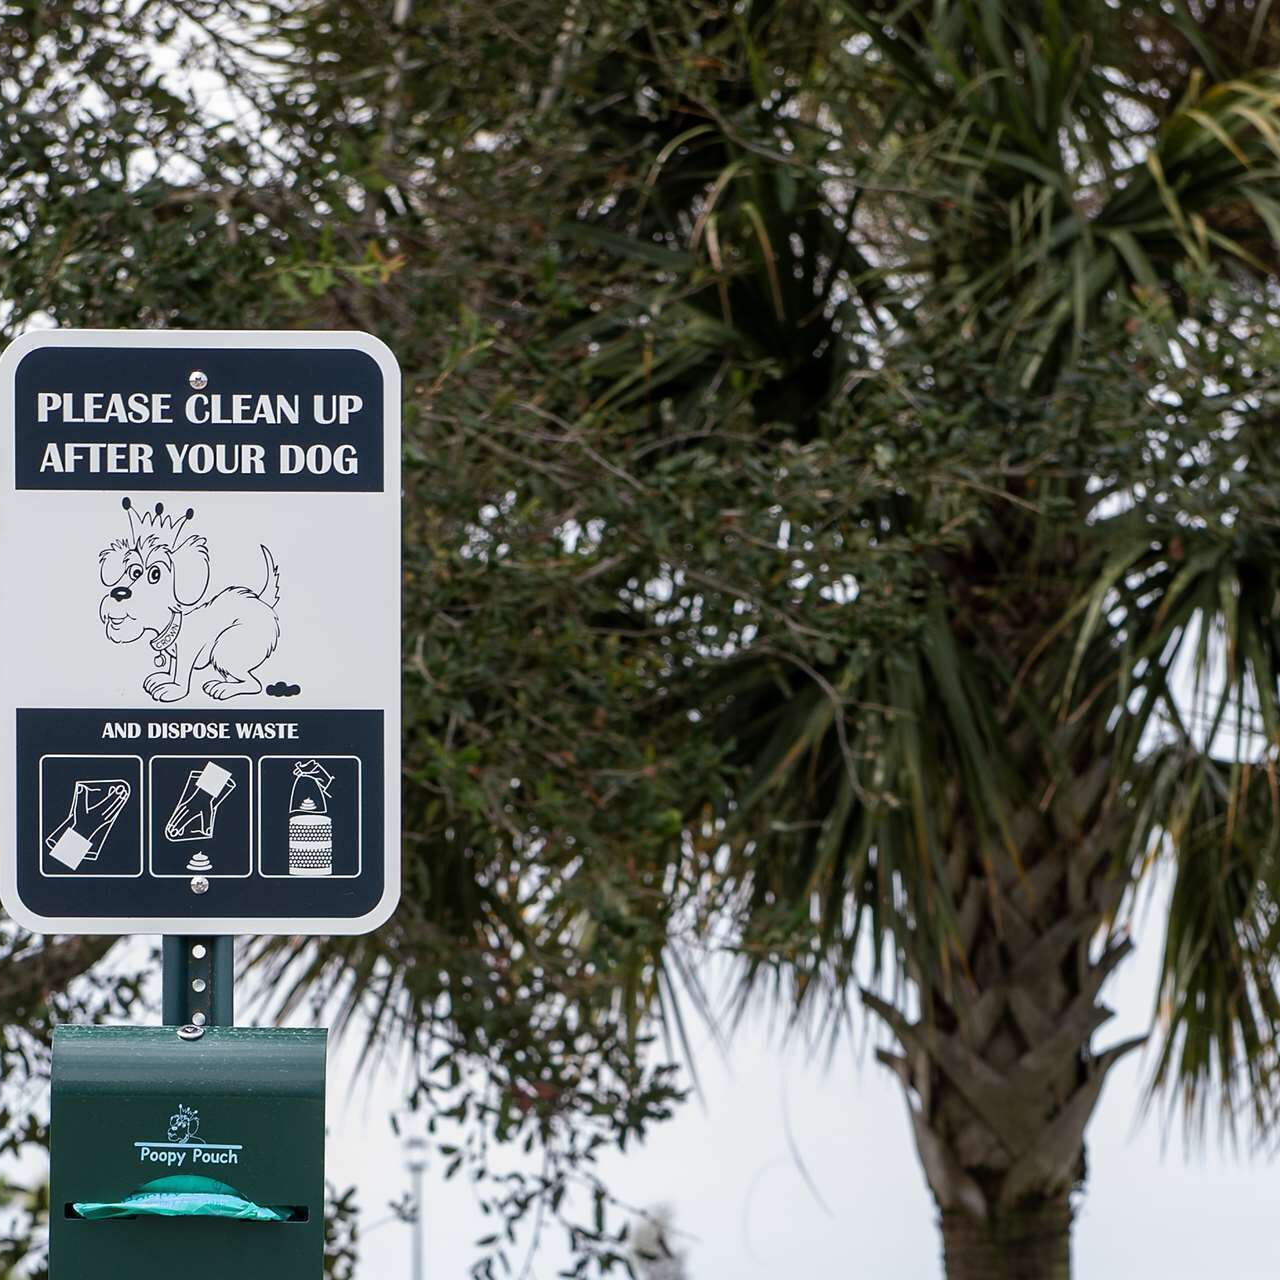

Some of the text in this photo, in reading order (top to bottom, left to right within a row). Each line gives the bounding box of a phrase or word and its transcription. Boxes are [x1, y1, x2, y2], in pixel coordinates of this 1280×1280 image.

[38, 393, 363, 424] PLEASE CLEAN UP
[40, 443, 358, 474] AFTER YOUR DOG
[156, 624, 179, 649] CROWN
[102, 723, 299, 739] AND DISPOSE WASTE
[140, 1147, 238, 1166] Poopy Pouch
